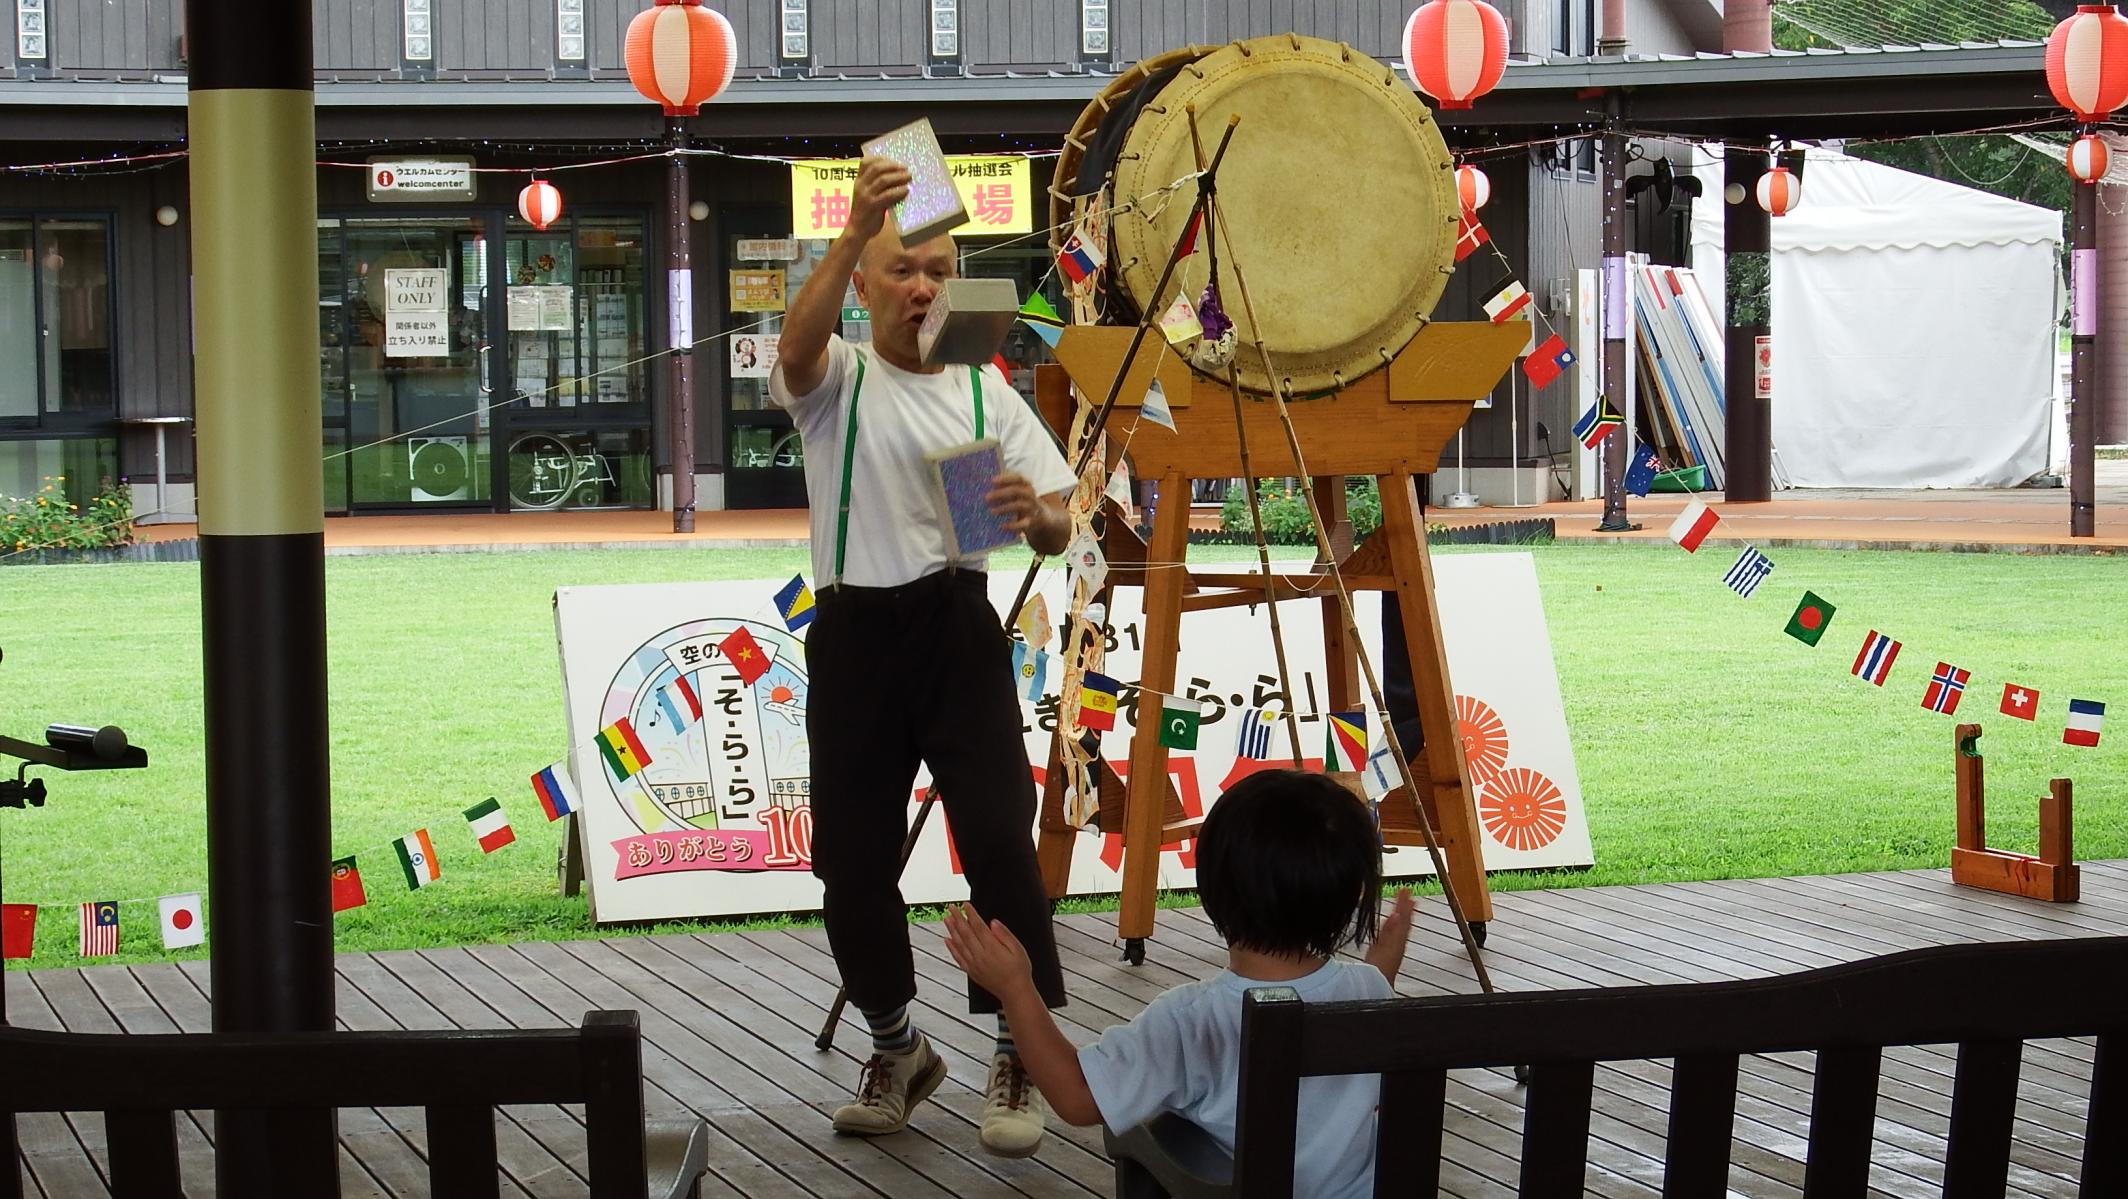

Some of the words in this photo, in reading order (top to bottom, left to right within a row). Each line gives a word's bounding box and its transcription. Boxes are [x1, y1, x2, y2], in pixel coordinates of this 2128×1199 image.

[397, 180, 464, 188] welcomcenter
[396, 276, 437, 288] STAFF
[397, 292, 435, 304] ONLY
[395, 322, 437, 330] 関係者以外
[388, 335, 447, 346] 立ち入り禁止
[628, 836, 753, 867] ありがとう
